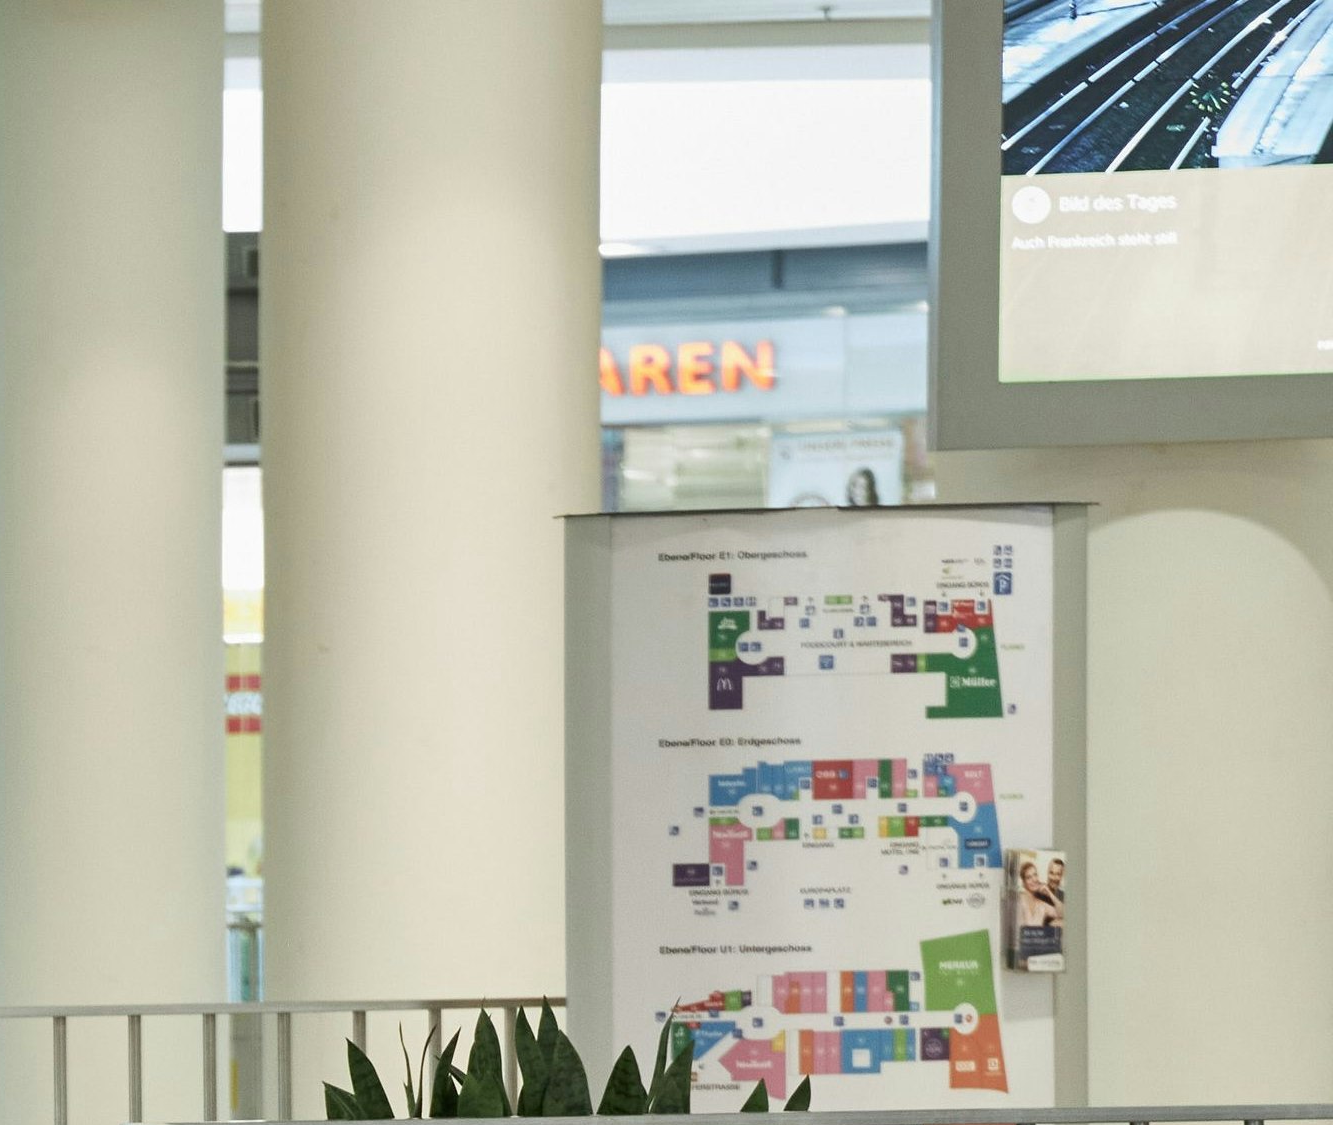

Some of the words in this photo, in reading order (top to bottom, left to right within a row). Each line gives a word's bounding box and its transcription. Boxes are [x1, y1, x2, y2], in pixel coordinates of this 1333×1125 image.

[1059, 195, 1089, 212] Bild
[1093, 194, 1123, 211] des
[1127, 193, 1177, 213] Tages
[1011, 235, 1045, 250] Auch
[658, 550, 716, 562] Ebene/Floor
[737, 550, 807, 561] Obergeschoss
[658, 738, 716, 748] Ebene/Floor
[737, 737, 801, 747] Erdgeschoss
[659, 945, 717, 955] Ebene/Floor
[739, 944, 813, 955] Untergeschoss
